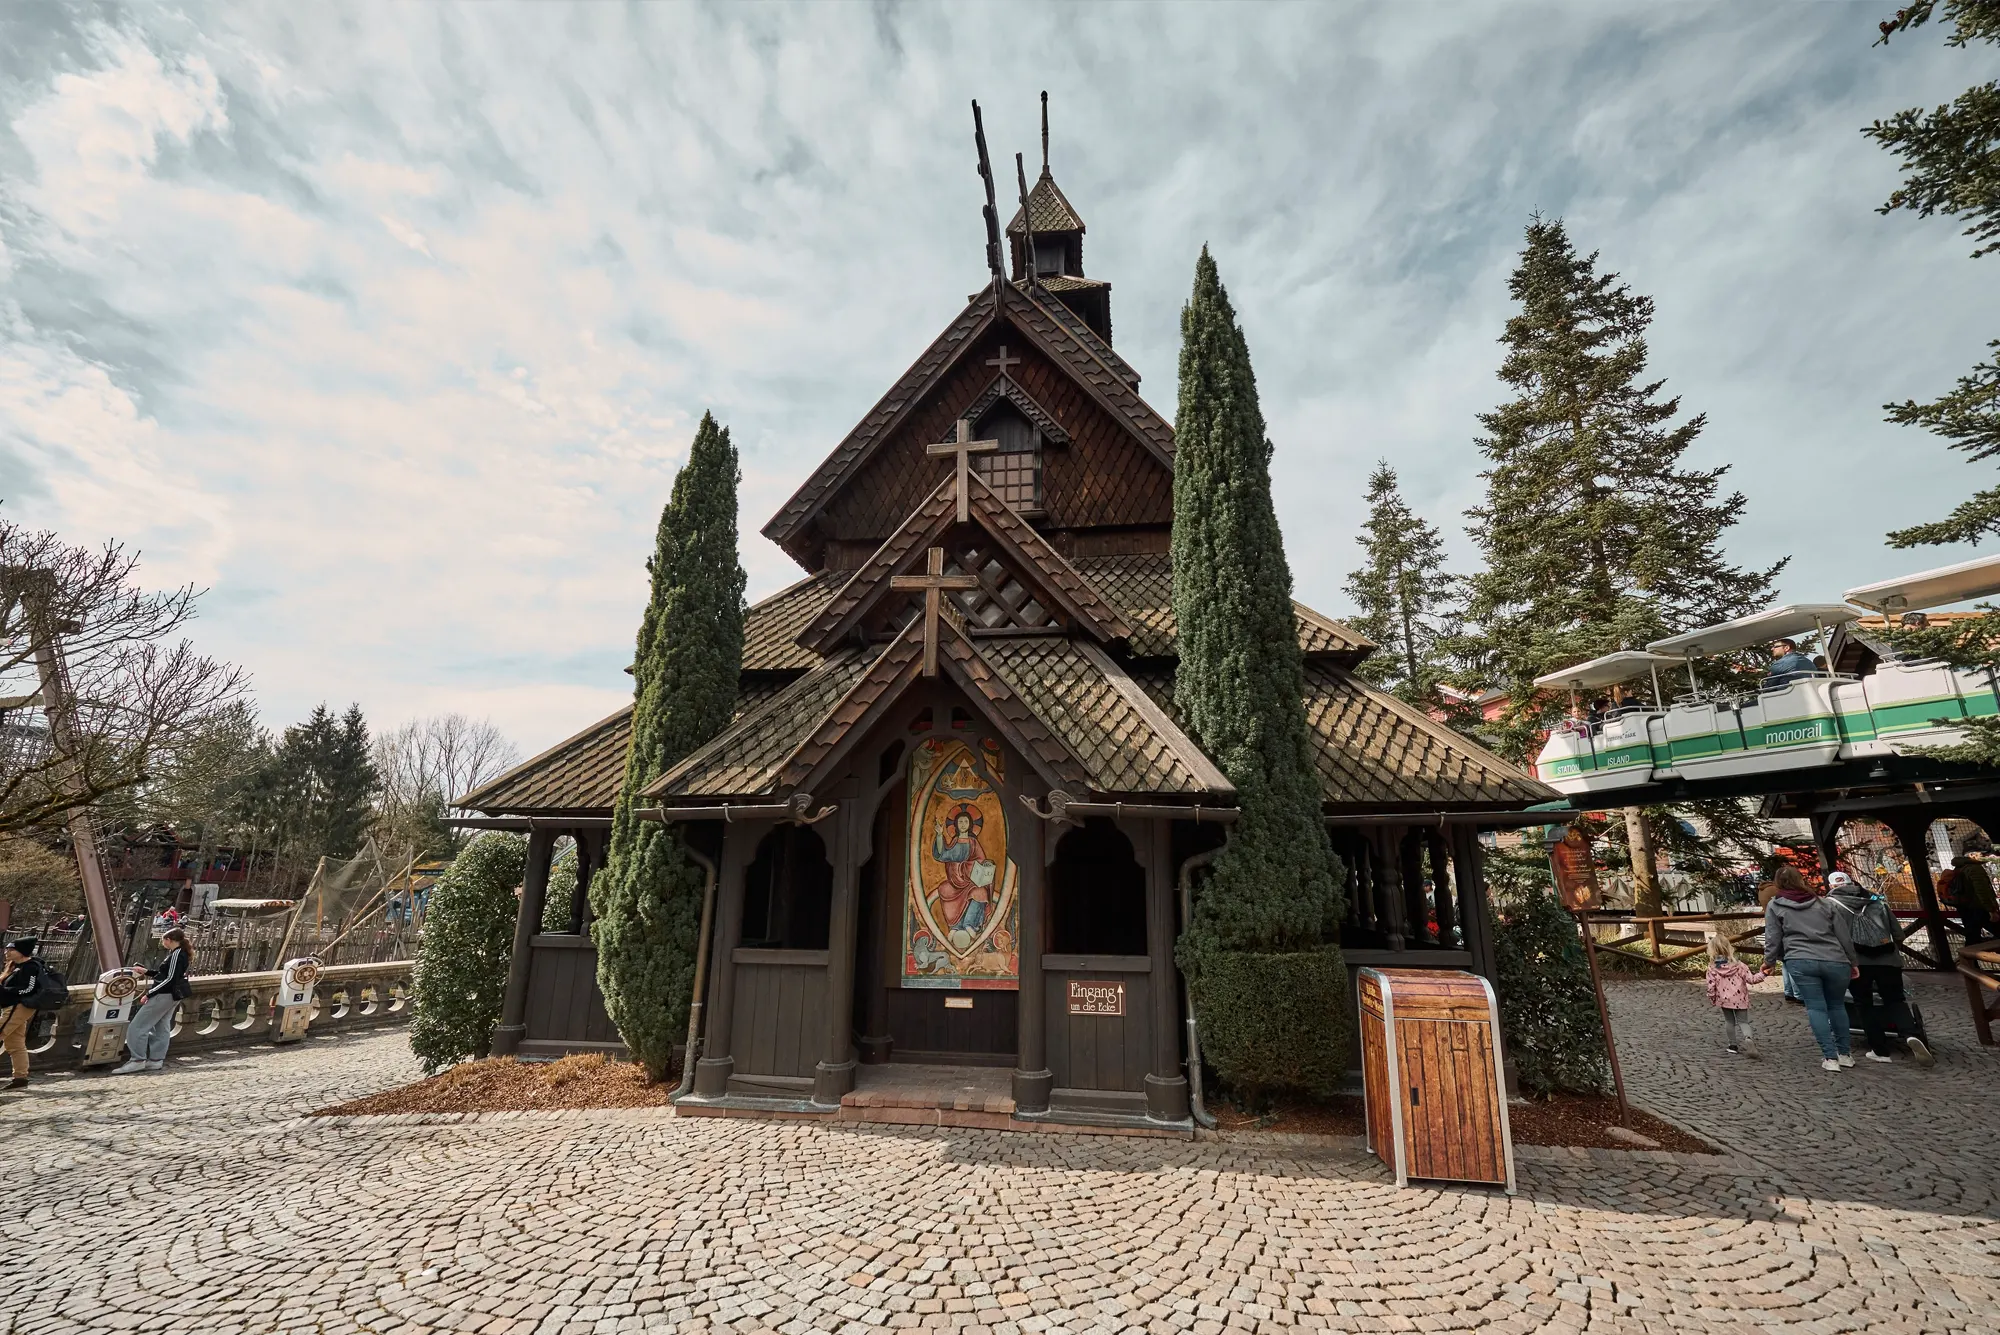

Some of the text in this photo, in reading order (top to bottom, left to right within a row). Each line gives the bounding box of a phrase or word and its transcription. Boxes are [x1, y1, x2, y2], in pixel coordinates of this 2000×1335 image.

[1766, 723, 1822, 744] monorail
[1557, 754, 1630, 775] STATION ISLAND
[1071, 982, 1117, 1003] Eingang
[1070, 1002, 1116, 1012] um die Ecke
